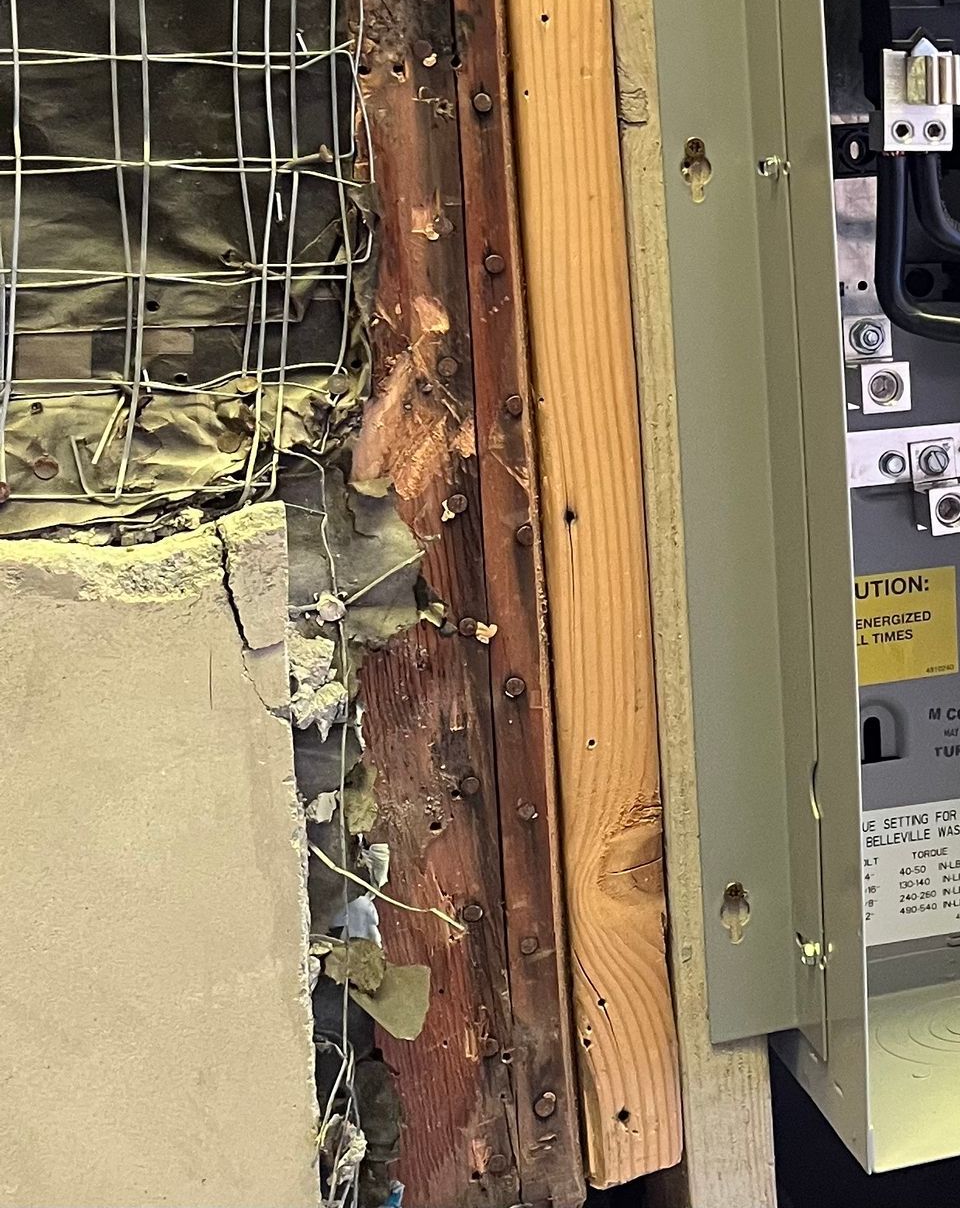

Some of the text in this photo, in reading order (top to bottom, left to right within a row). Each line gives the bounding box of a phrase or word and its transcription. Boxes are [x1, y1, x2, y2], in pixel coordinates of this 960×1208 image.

[855, 575, 929, 599] UTION:
[856, 611, 931, 630] ENERGIZED
[872, 629, 913, 644] TIMES
[928, 707, 941, 720] M
[861, 809, 957, 833] UE SETTING FOR
[866, 828, 931, 848] BELLEVILLE
[912, 847, 949, 859] TORQUE
[899, 865, 927, 876] 40-50
[899, 877, 931, 889] 130-140
[899, 903, 938, 914] 490-540
